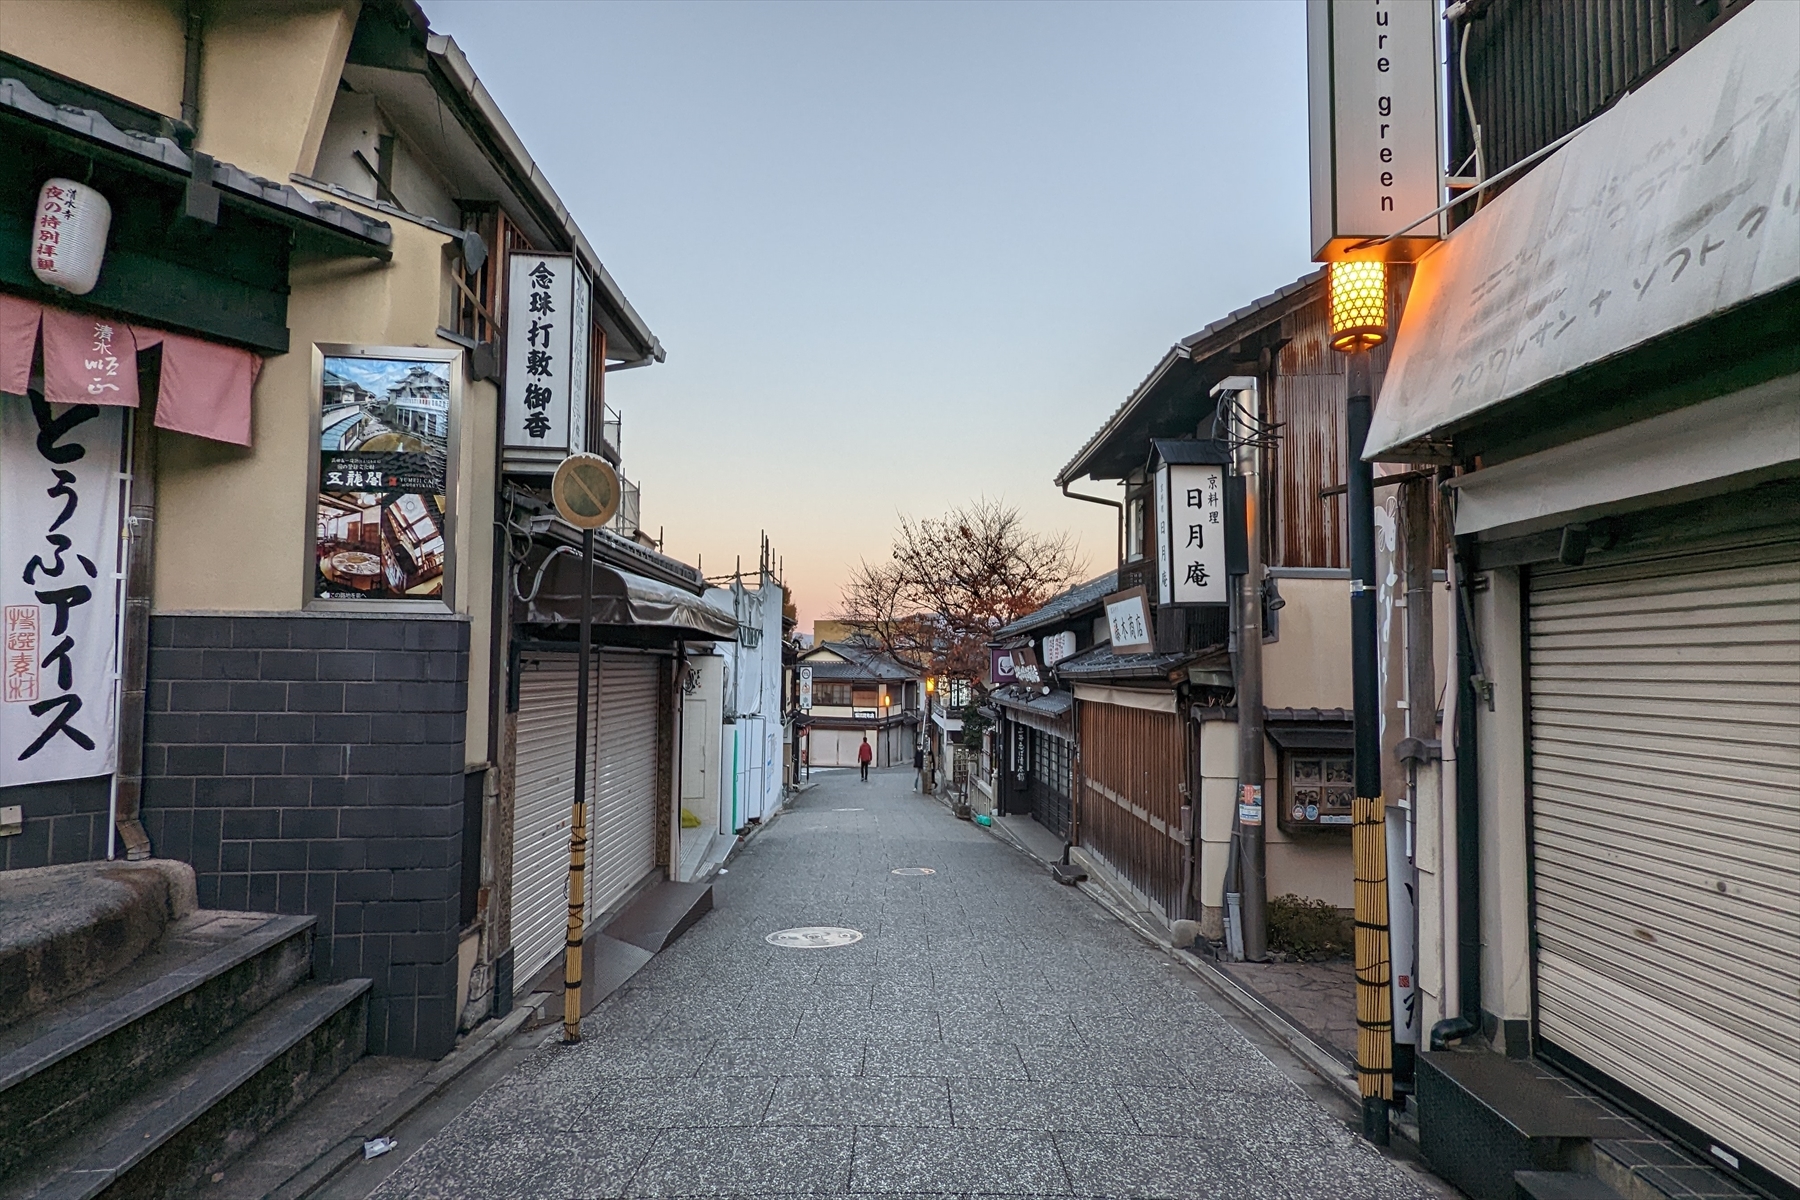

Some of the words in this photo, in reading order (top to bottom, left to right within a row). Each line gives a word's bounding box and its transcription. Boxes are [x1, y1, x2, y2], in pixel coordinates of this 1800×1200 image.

[1376, 0, 1390, 72] ure
[1378, 95, 1394, 211] green
[37, 185, 65, 273] 夜の特別拝観
[62, 188, 77, 221] 清水寺
[1184, 488, 1210, 587] 日月庵
[1207, 474, 1219, 524] 京料理
[18, 388, 100, 761] とうふアイス
